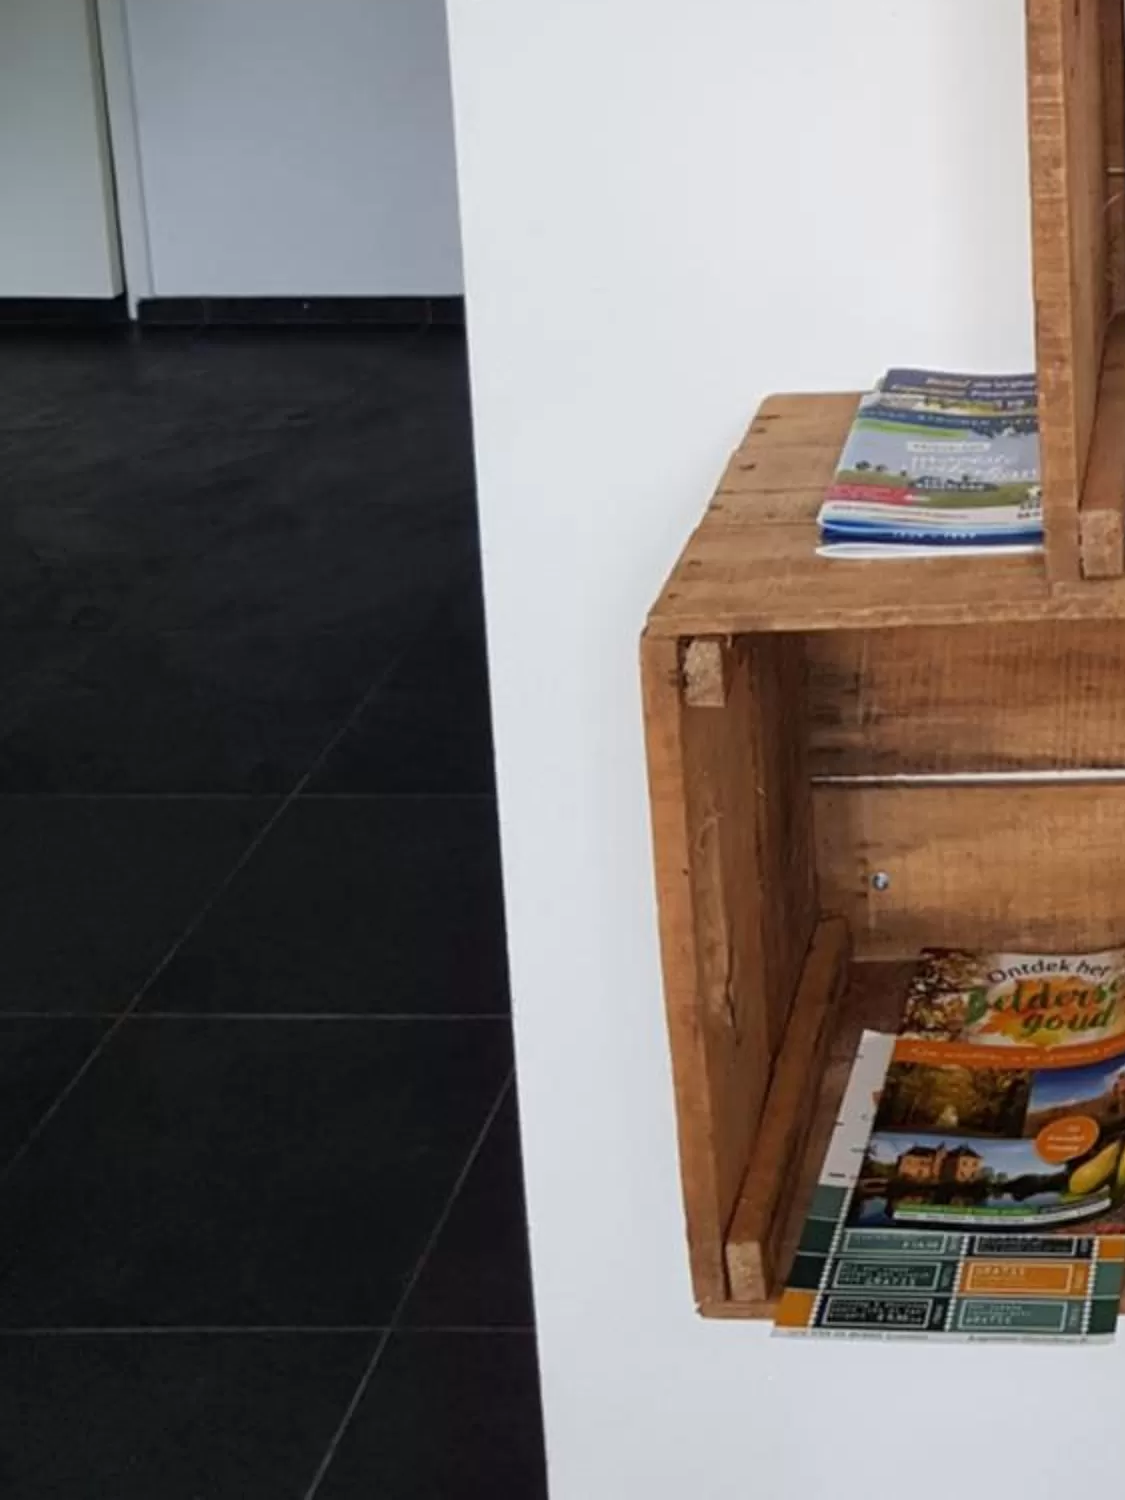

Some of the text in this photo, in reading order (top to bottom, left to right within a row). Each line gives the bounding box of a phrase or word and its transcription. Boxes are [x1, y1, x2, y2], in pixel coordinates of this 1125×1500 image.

[987, 958, 1111, 982] Ontdek het
[1022, 998, 1117, 1038] goud
